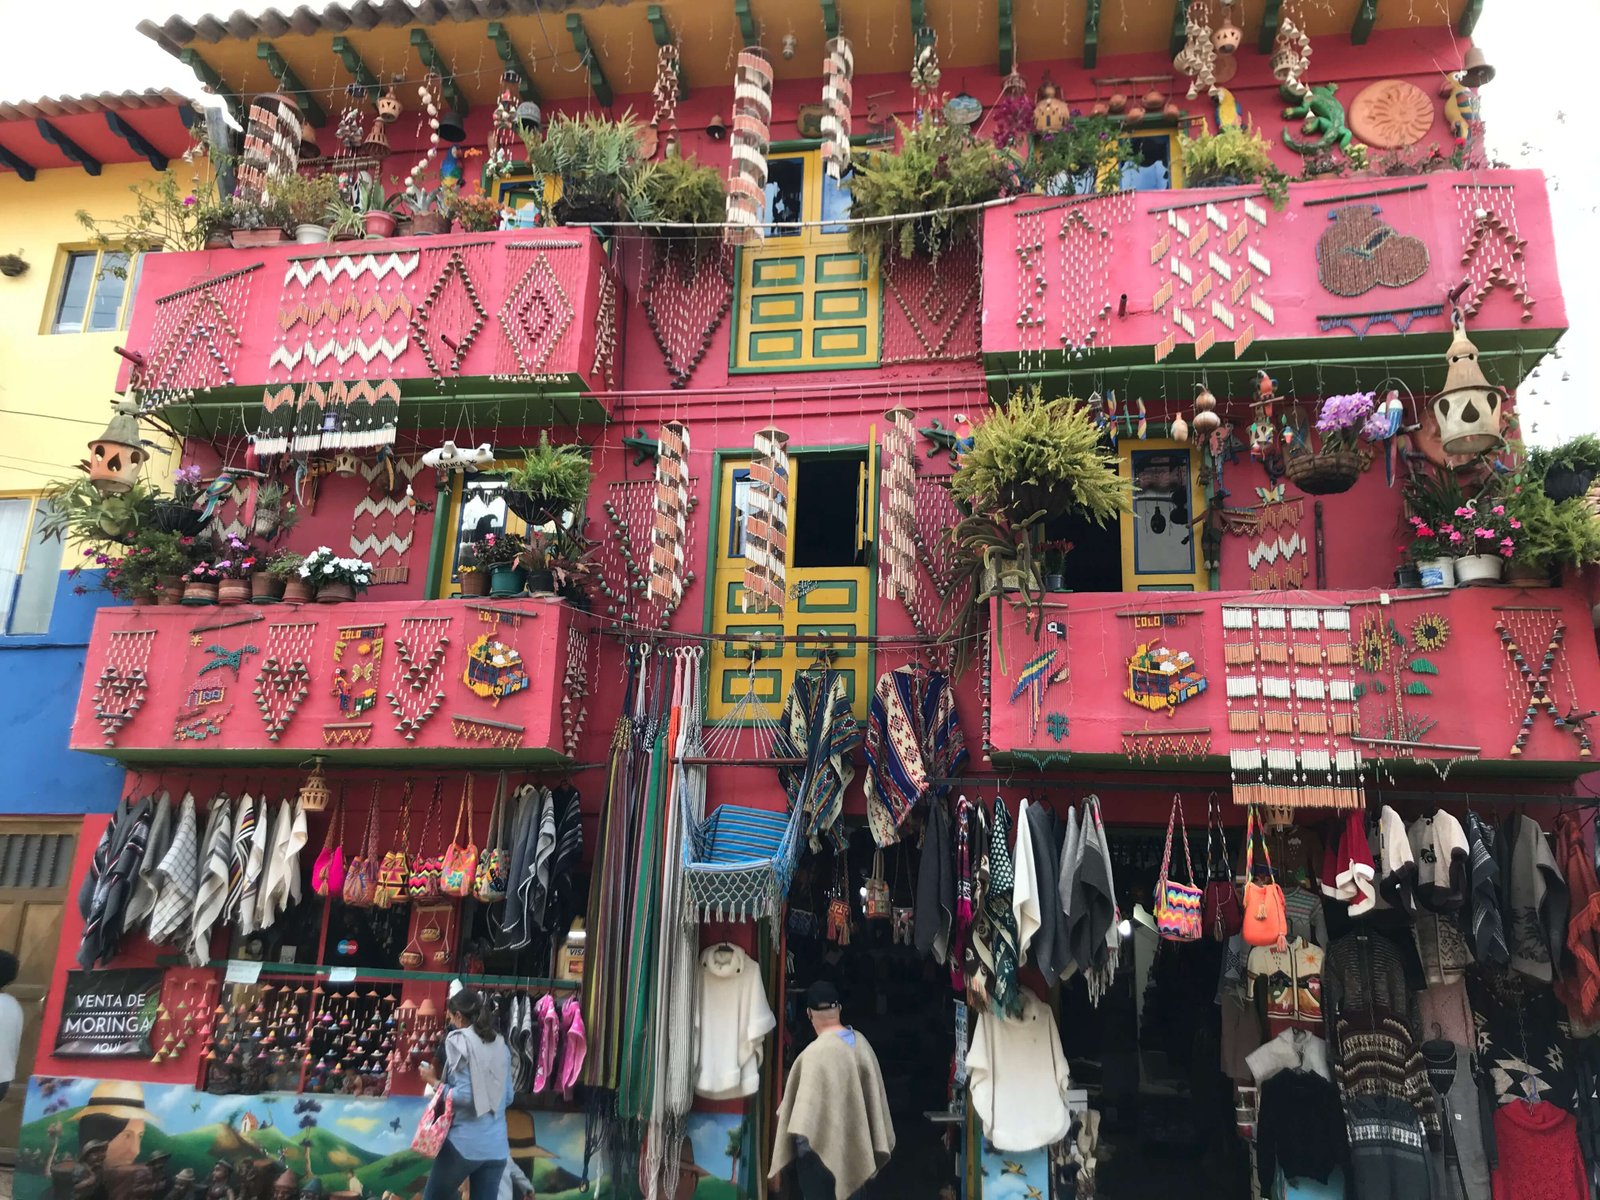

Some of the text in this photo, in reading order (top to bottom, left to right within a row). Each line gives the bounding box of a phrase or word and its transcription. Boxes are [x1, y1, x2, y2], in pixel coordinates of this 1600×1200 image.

[77, 993, 146, 1008] VENTA DE
[65, 1016, 151, 1034] MORINGA
